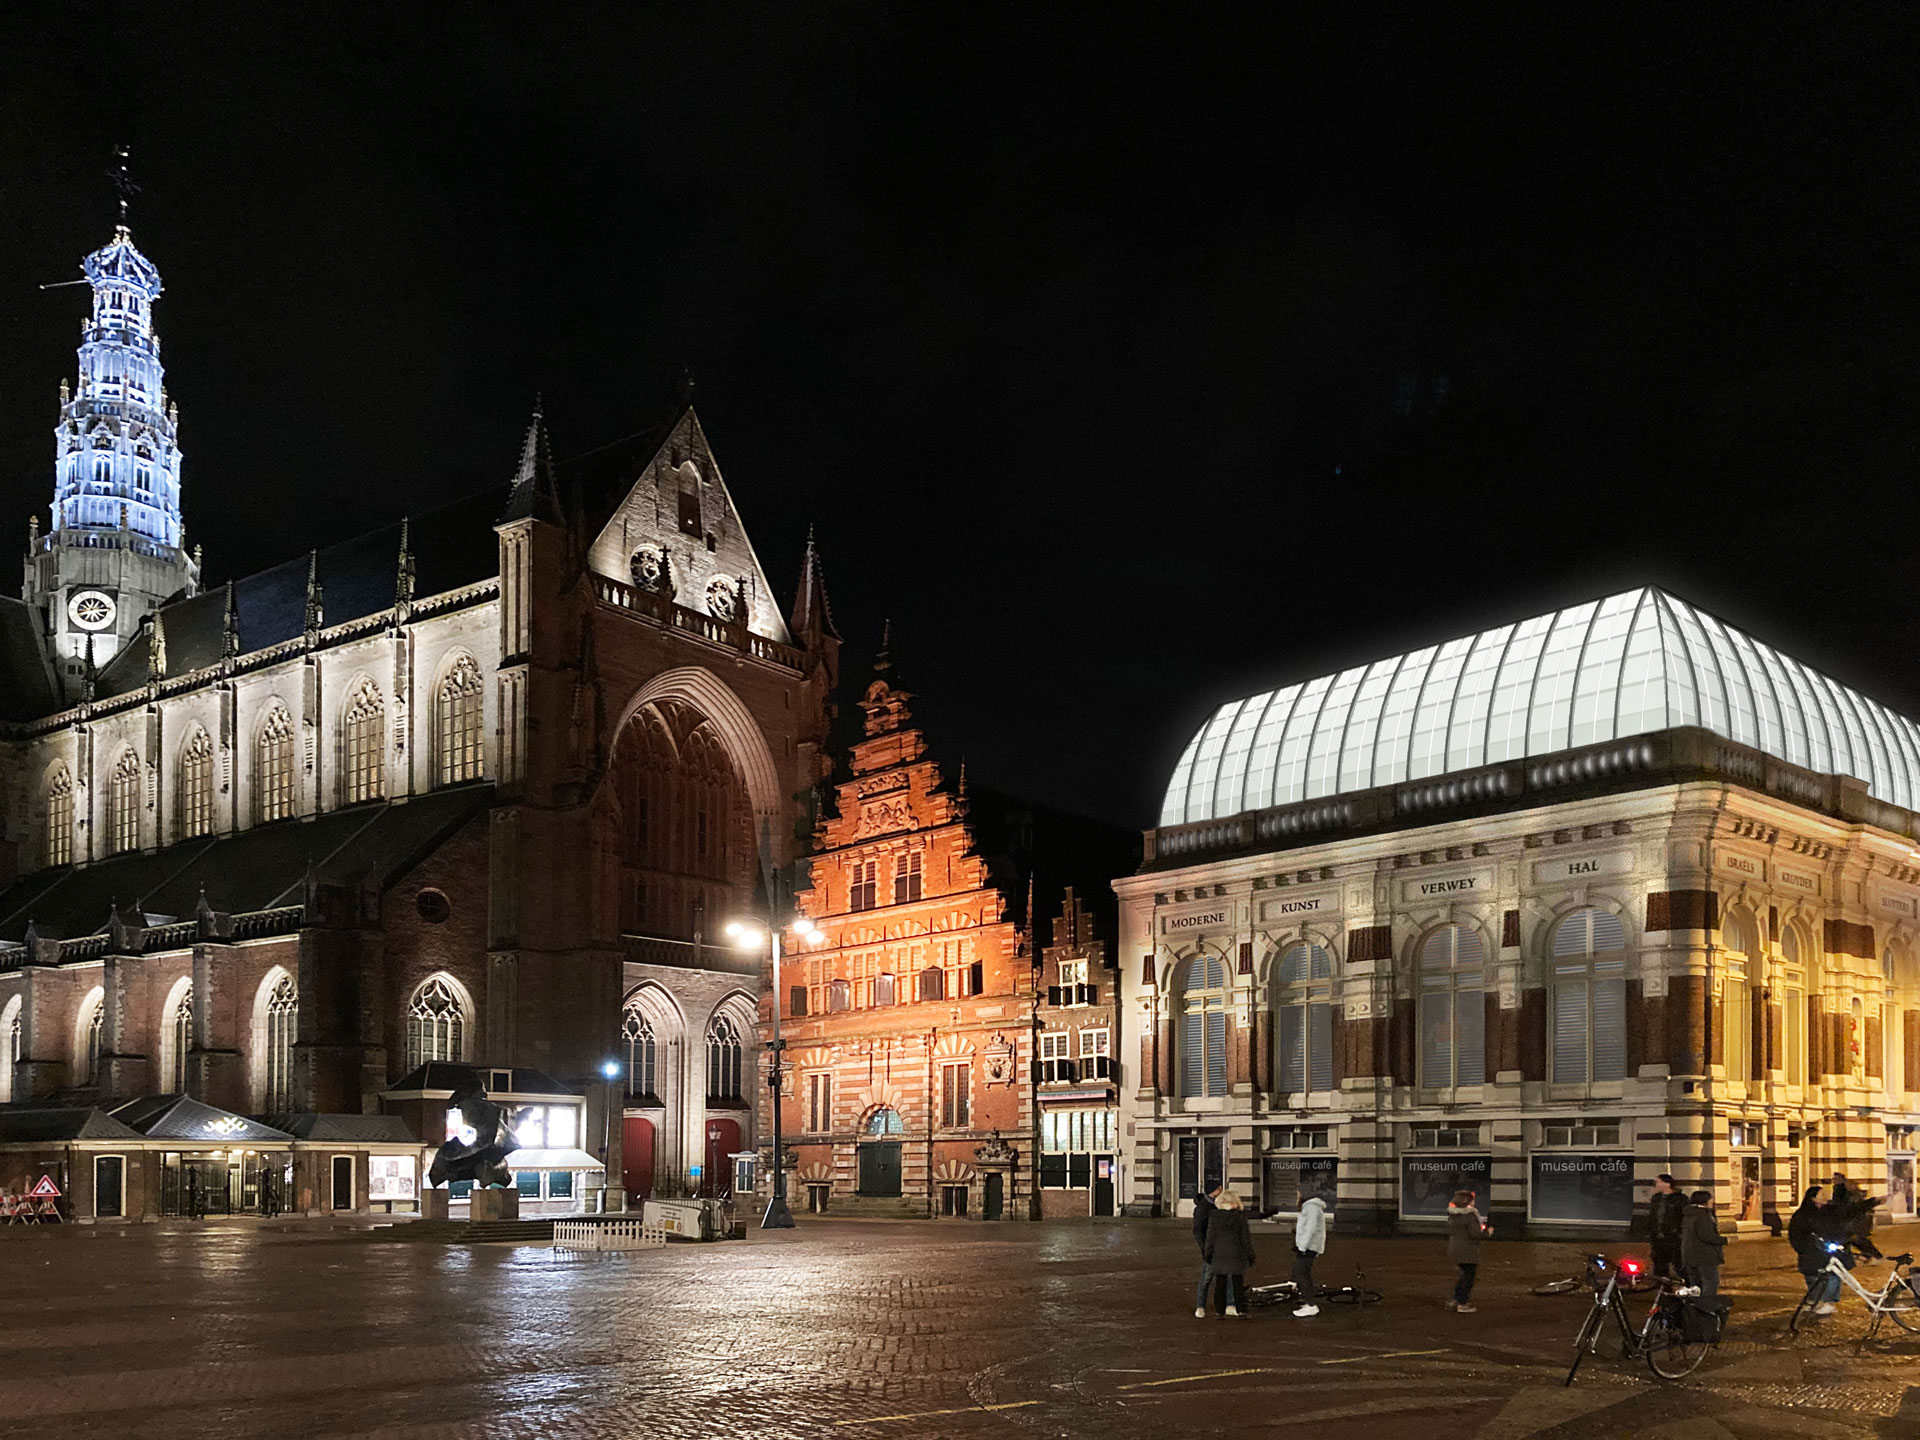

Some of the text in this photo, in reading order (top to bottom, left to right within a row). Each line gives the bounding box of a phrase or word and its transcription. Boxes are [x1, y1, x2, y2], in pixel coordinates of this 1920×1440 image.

[1568, 860, 1600, 875] HAL
[1420, 877, 1476, 894] VERWEY
[1281, 899, 1321, 913] KUNST
[1171, 912, 1225, 929] MODERNE
[1271, 1160, 1332, 1170] museum café
[1409, 1160, 1486, 1171] museum café
[1541, 1160, 1628, 1172] museum café
